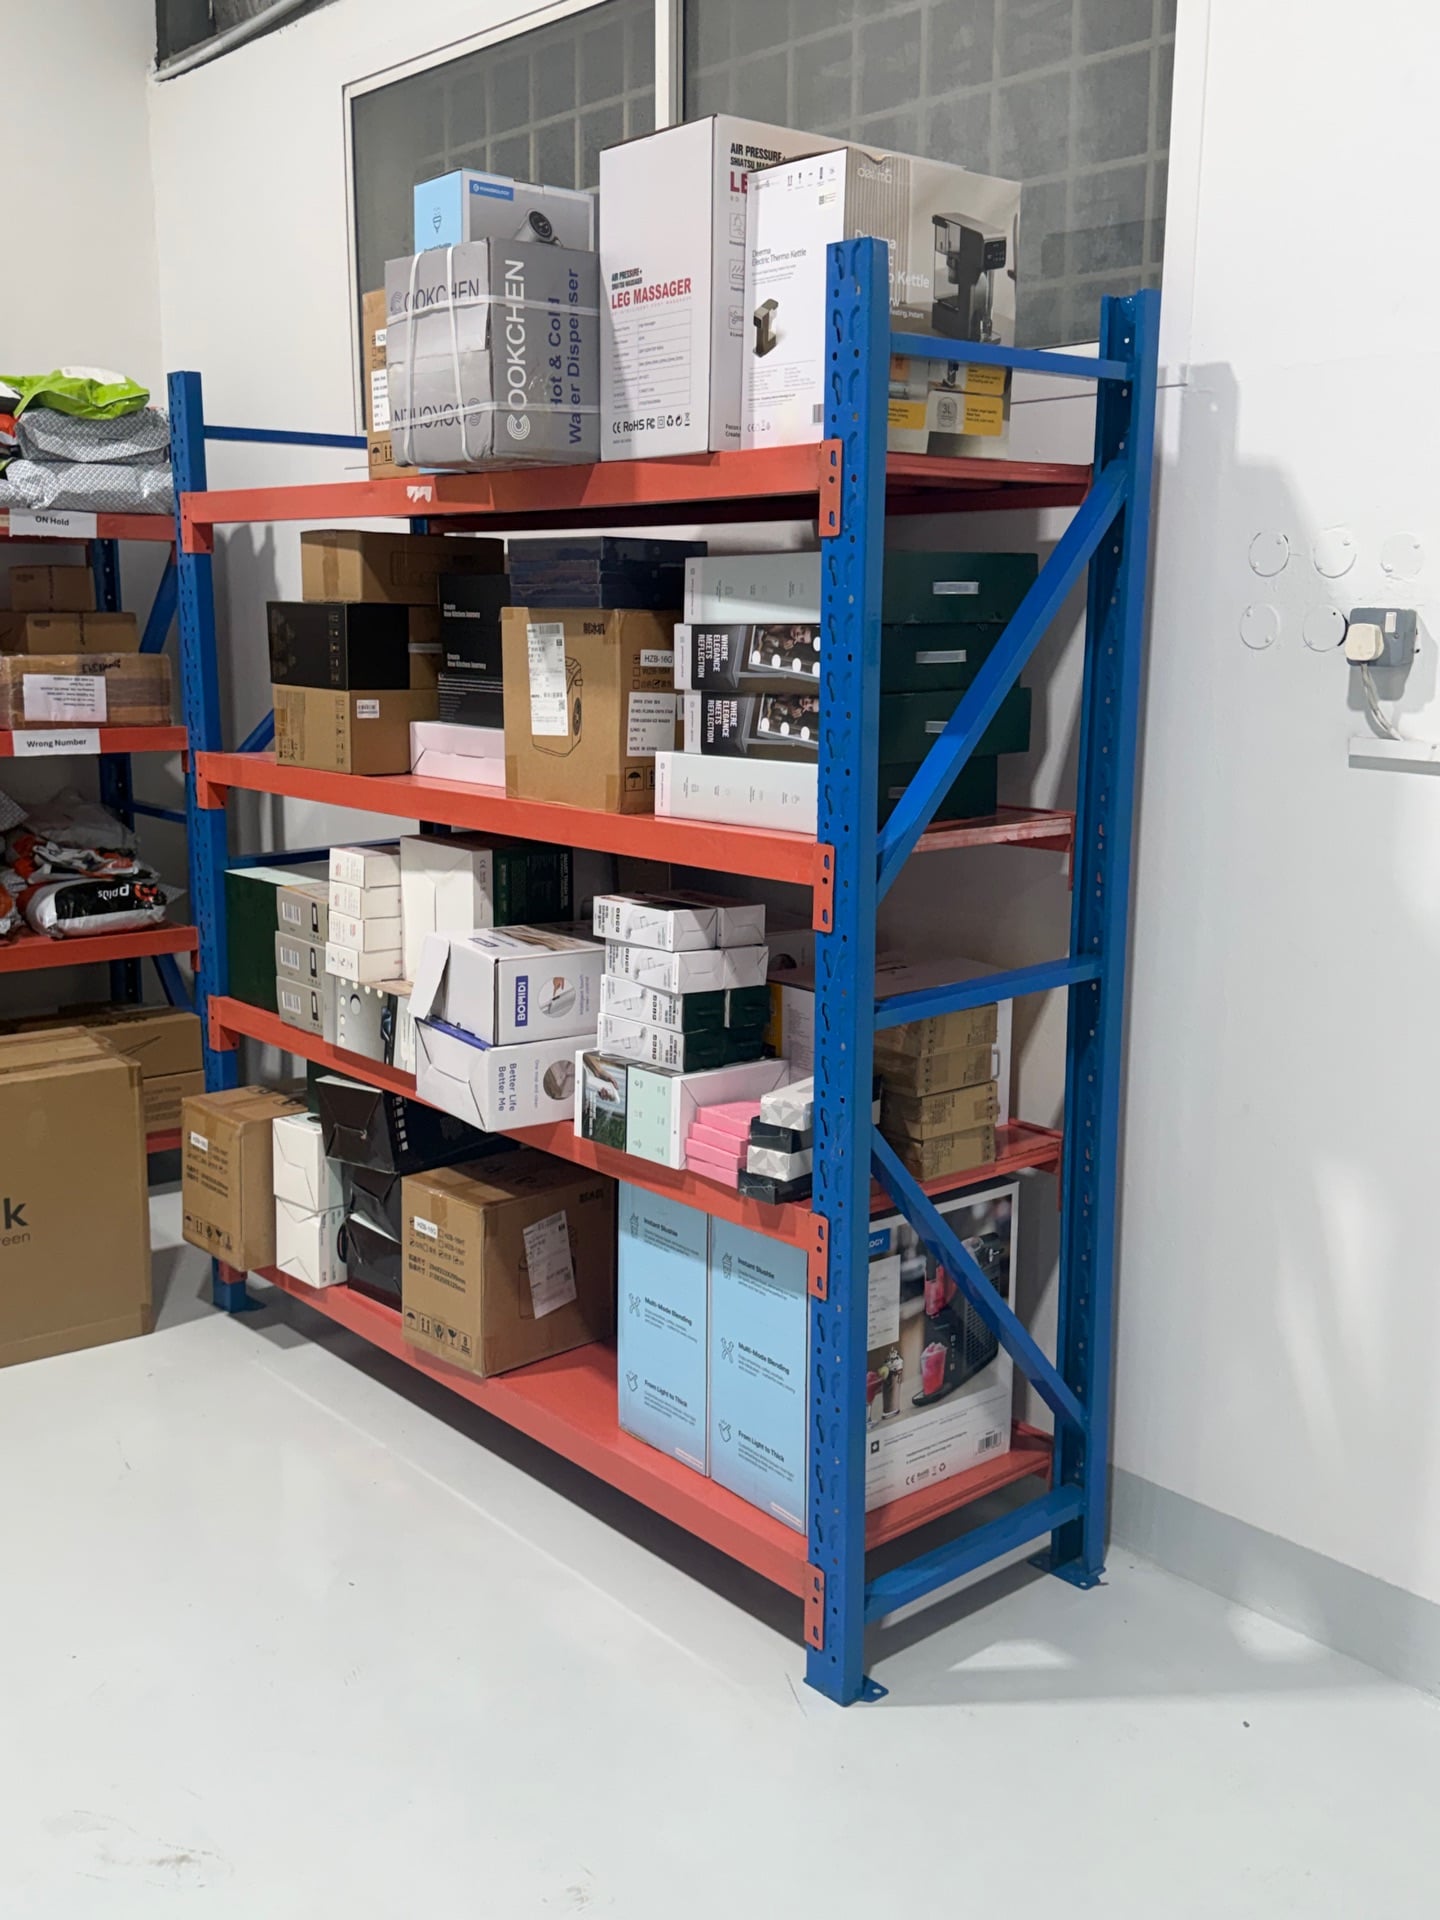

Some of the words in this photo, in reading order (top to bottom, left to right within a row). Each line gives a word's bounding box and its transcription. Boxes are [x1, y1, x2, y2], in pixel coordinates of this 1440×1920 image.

[730, 142, 743, 155] AIR
[730, 171, 747, 194] LE
[897, 271, 930, 288] Kettle
[612, 290, 631, 310] LEG
[633, 277, 692, 305] MASSAGER
[567, 269, 582, 377] Dispeser
[505, 259, 531, 441] COOKCHEN
[550, 355, 562, 369] &
[569, 383, 582, 444] Waer
[623, 418, 645, 433] RoHS
[35, 515, 49, 524] ON
[50, 517, 70, 526] Hold
[644, 654, 673, 664] HZB-16G
[697, 634, 705, 679] REFLECTION
[705, 634, 713, 660] MEETS
[713, 634, 721, 673] ELEGANCE
[721, 634, 729, 661] WHERE
[707, 699, 715, 743] REFLECTION
[714, 699, 722, 726] MEETS
[722, 700, 730, 738] ELEGANCE
[730, 700, 738, 728] WHERE
[26, 740, 54, 748] Wrong
[54, 738, 87, 747] Number
[517, 981, 527, 1021] BOMIDI
[498, 1066, 507, 1094] Better
[509, 1062, 518, 1091] Better
[498, 1097, 507, 1112] Me
[508, 1094, 518, 1112] Life
[0, 1232, 31, 1247] een
[671, 1310, 692, 1327] Blending
[767, 1357, 789, 1376] Blending
[644, 1379, 656, 1390] From
[656, 1386, 669, 1397] Light
[738, 1430, 751, 1441] From
[751, 1438, 764, 1449] Light
